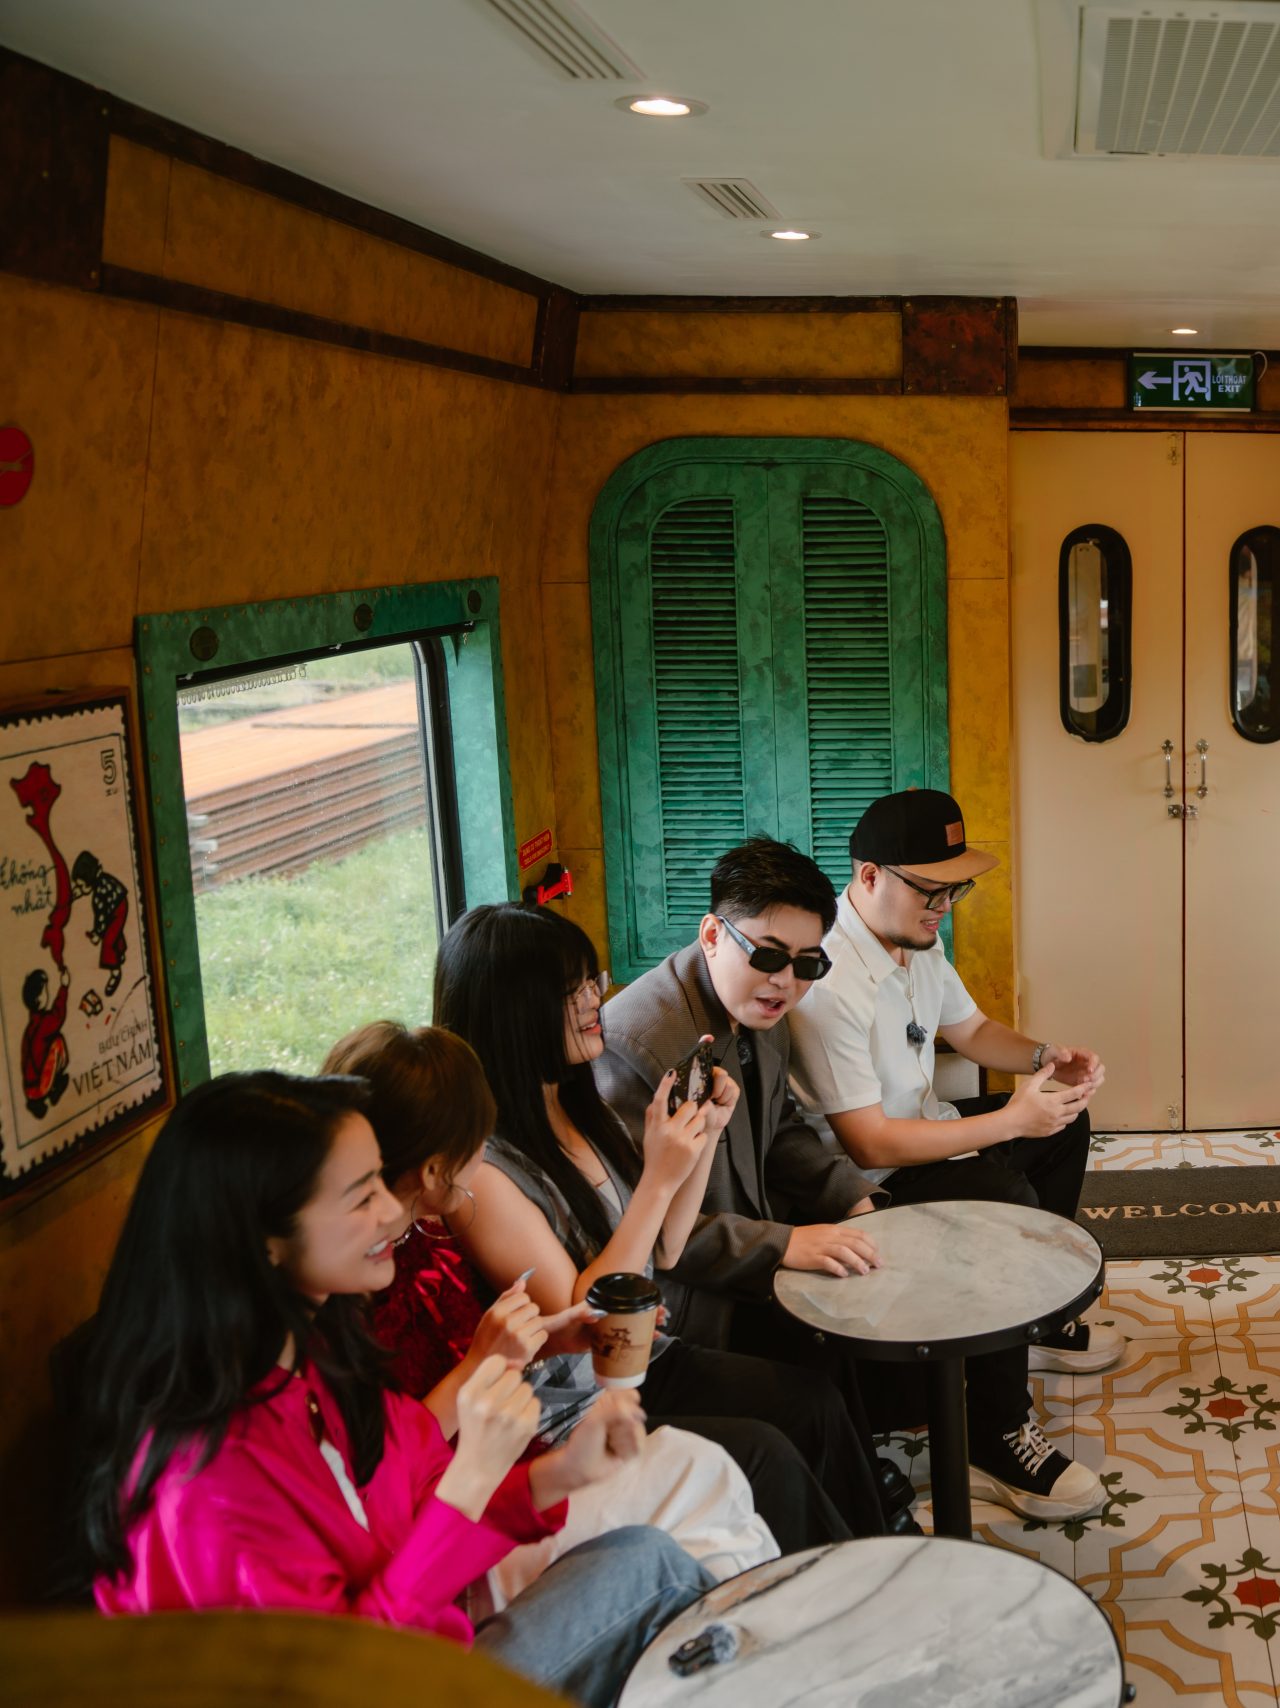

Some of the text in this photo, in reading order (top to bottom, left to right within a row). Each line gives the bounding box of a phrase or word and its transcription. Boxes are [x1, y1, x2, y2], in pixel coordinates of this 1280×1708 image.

[1218, 384, 1241, 393] EXIT
[100, 748, 117, 785] 5
[115, 1039, 152, 1075] NAM
